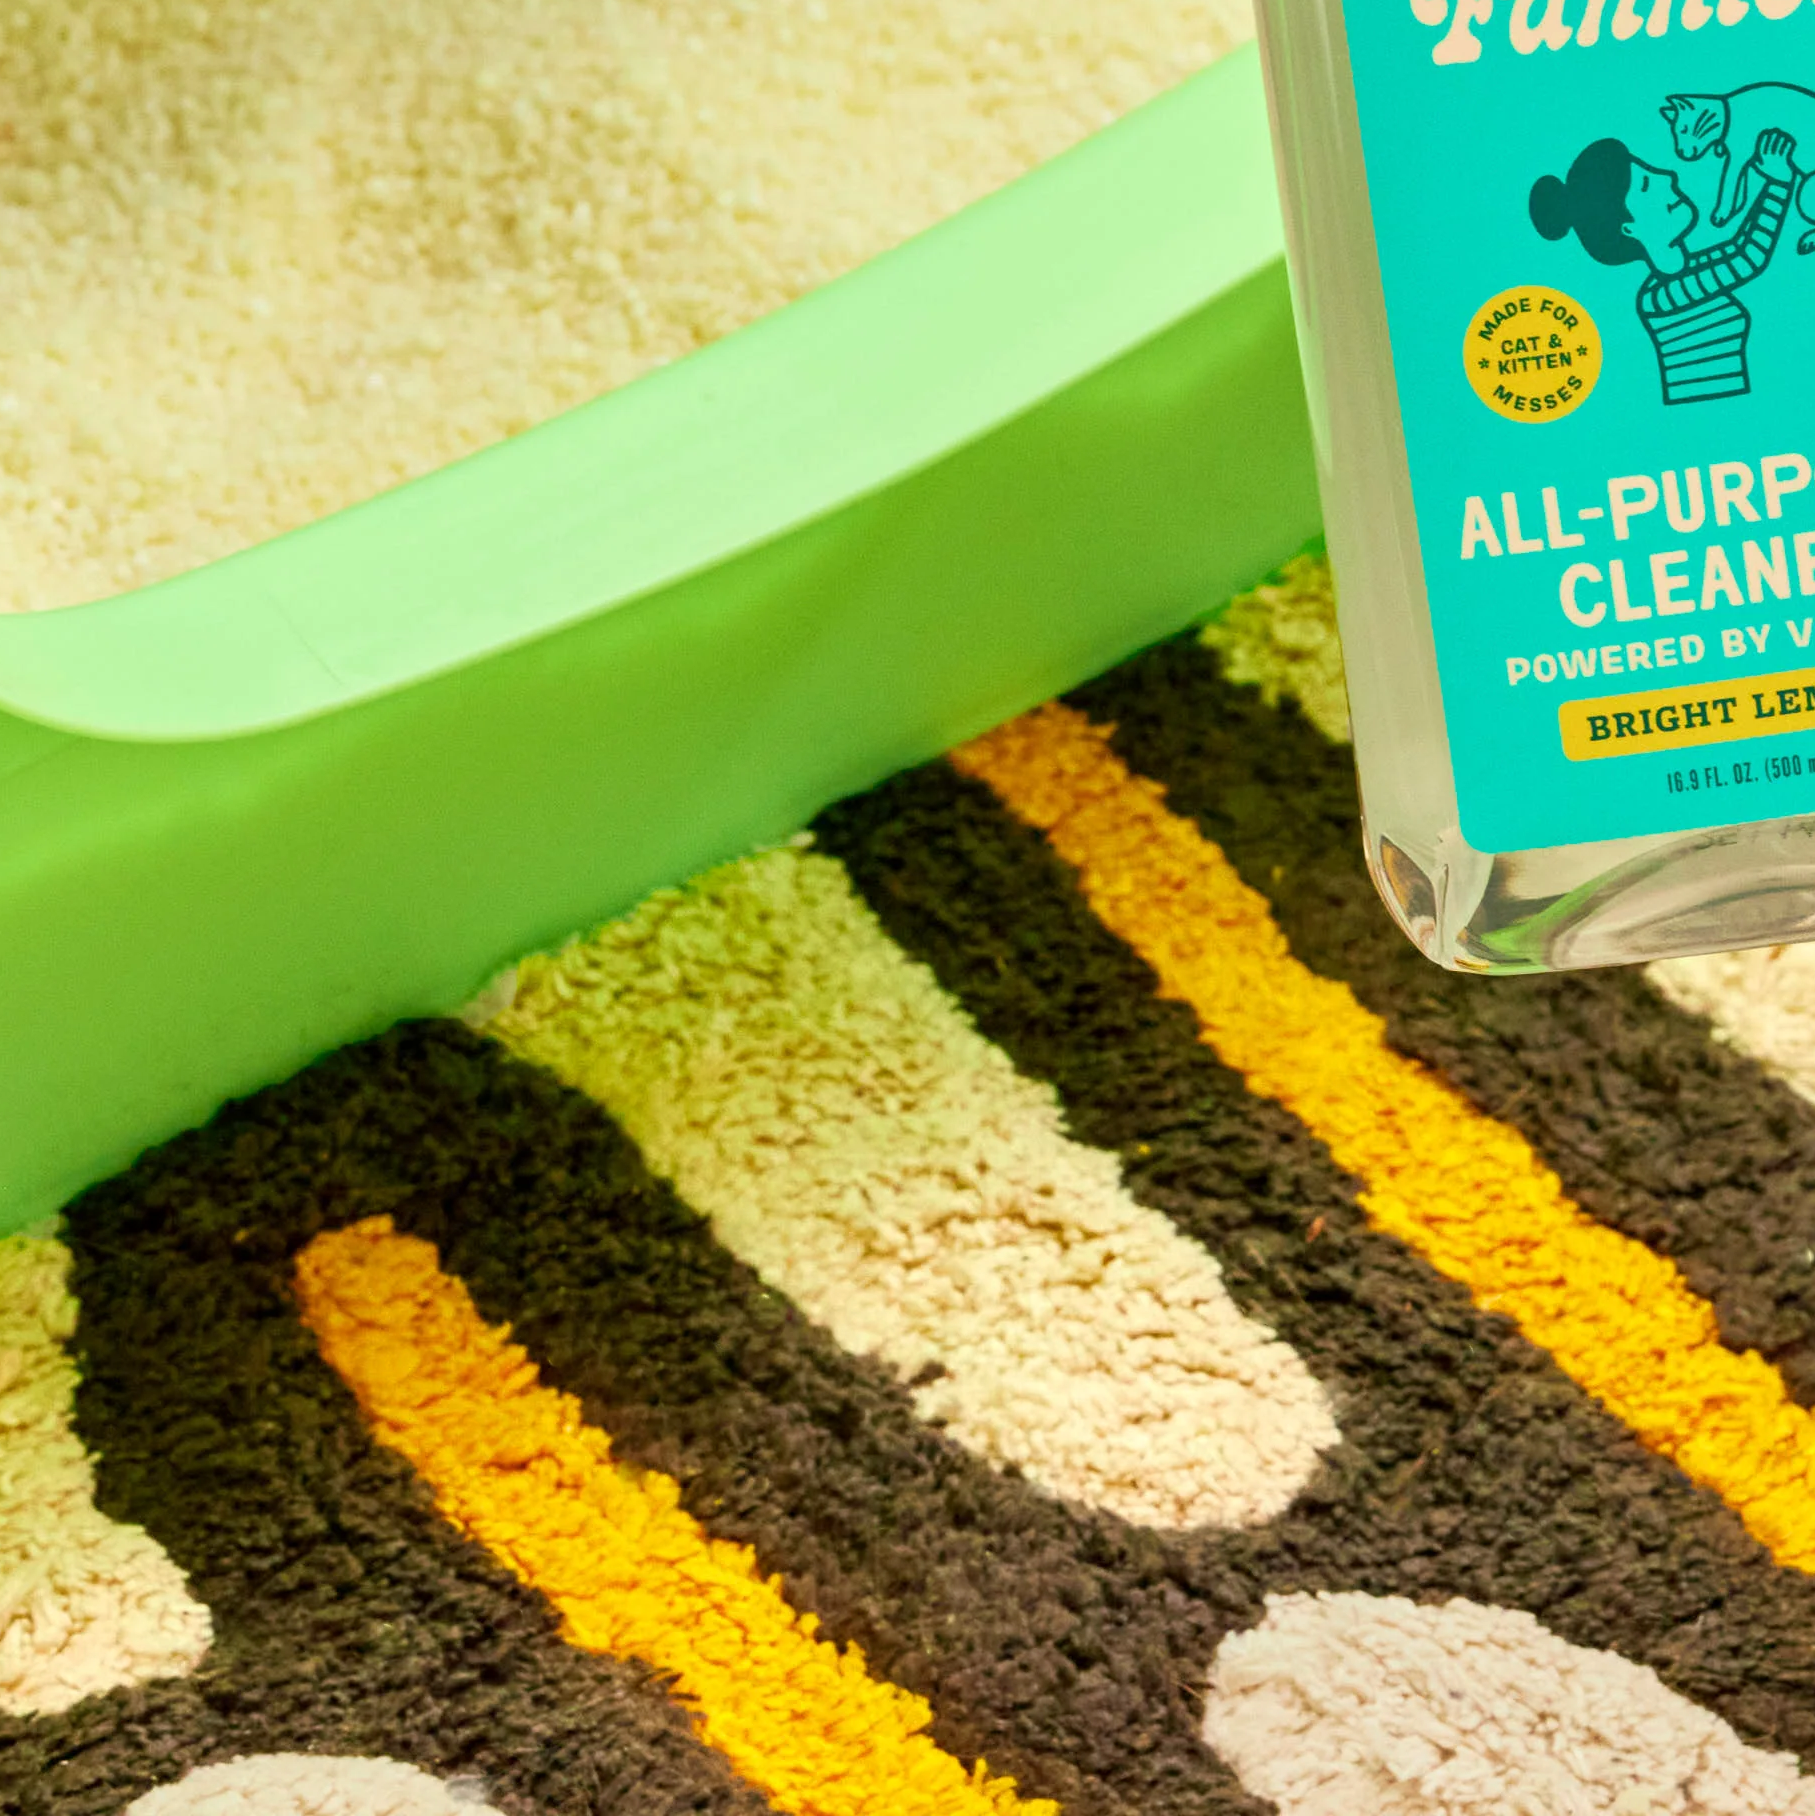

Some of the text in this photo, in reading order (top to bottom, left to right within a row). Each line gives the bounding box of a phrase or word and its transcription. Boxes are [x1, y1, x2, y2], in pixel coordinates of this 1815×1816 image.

[1478, 297, 1579, 341] MADE FOR
[1498, 352, 1572, 375] KITTEN
[1501, 333, 1562, 355] CAT &
[1493, 375, 1582, 413] MESSES
[1506, 634, 1705, 686] POWERED
[1721, 624, 1770, 658] BY
[1586, 697, 1737, 742] BRIGHT
[1667, 769, 1699, 793] 16.9
[1704, 766, 1728, 788] FL.
[1733, 761, 1759, 784] OZ.
[1765, 754, 1802, 783] (500
